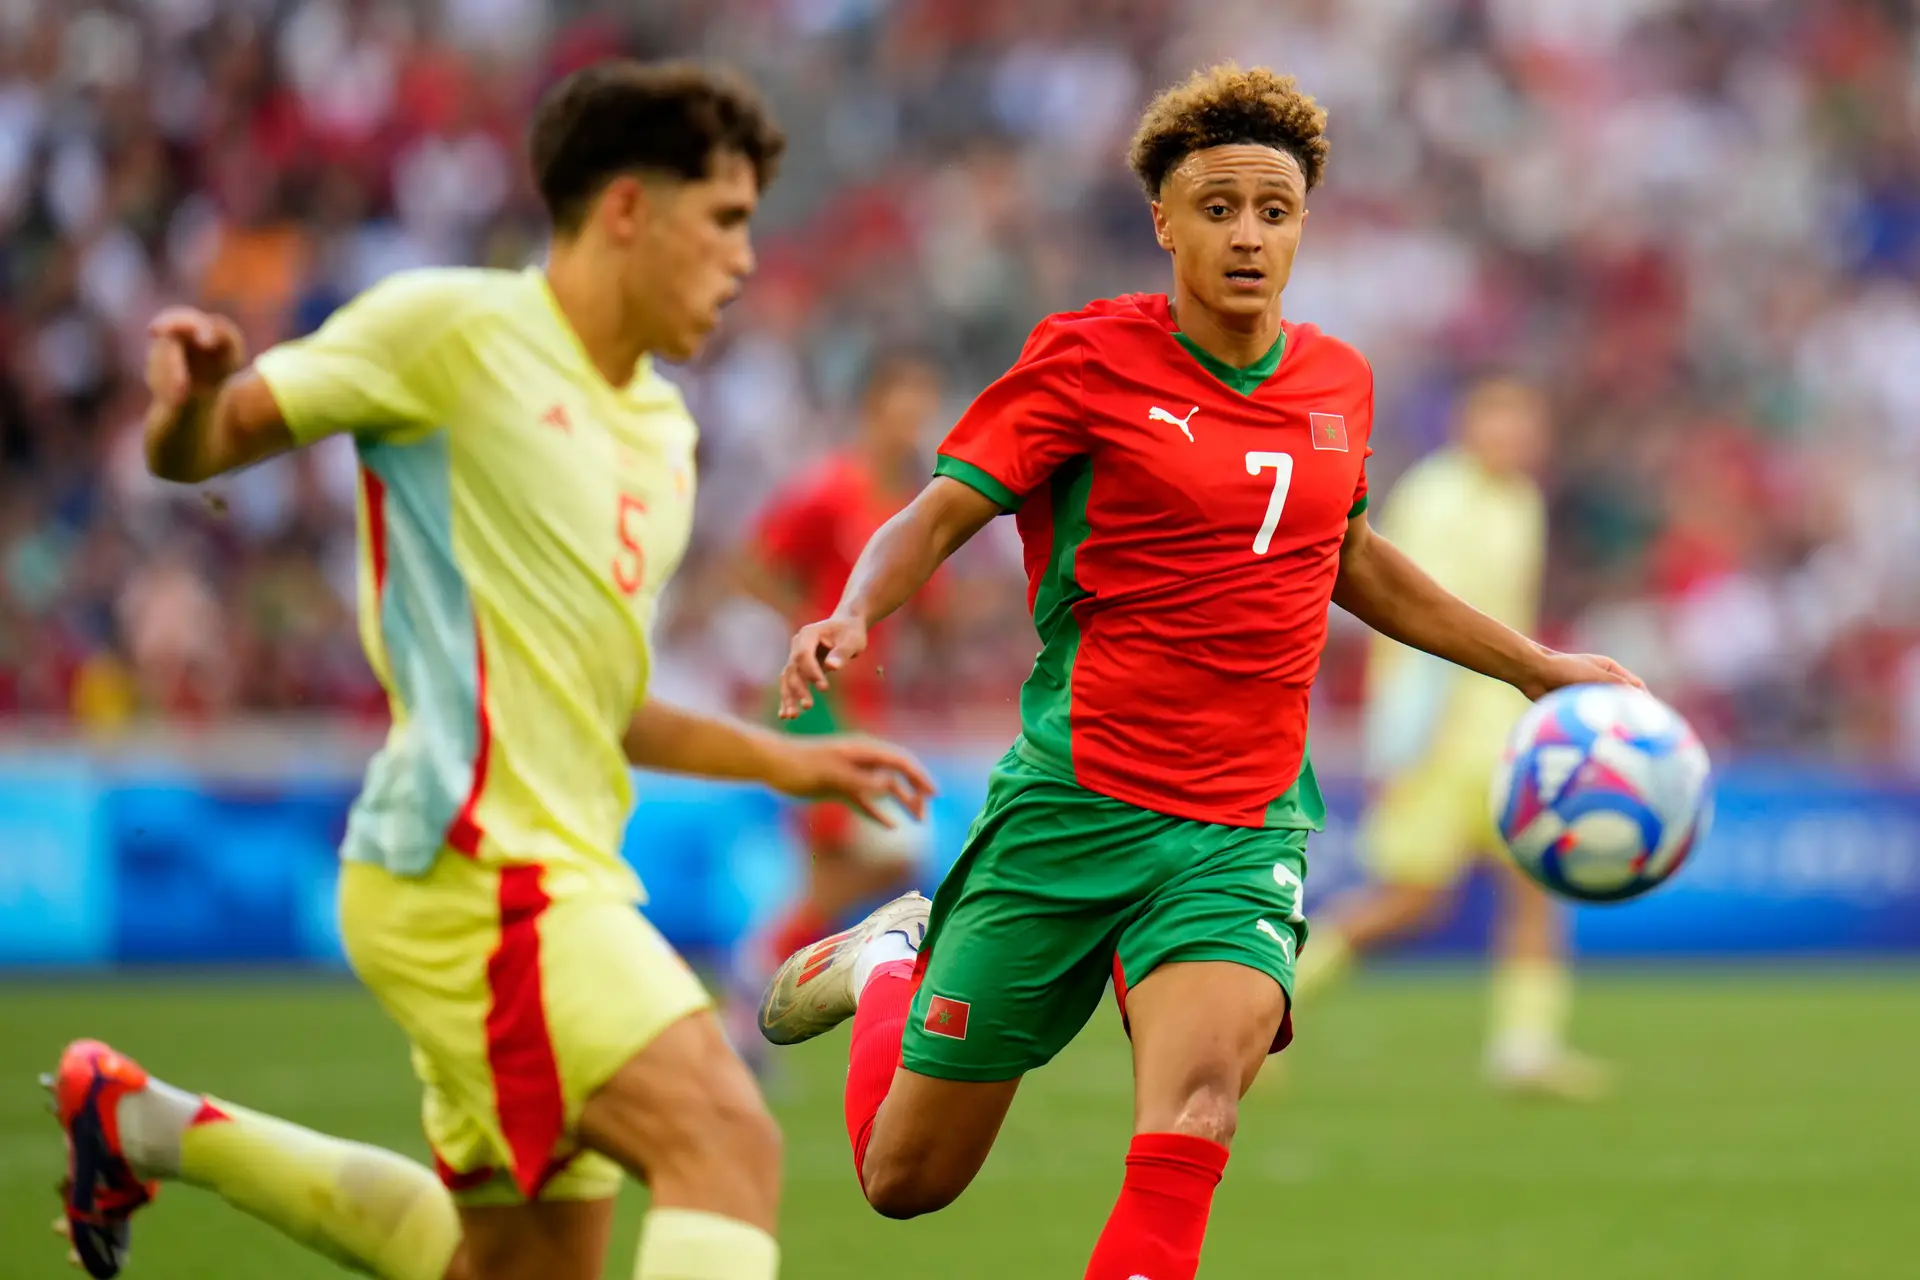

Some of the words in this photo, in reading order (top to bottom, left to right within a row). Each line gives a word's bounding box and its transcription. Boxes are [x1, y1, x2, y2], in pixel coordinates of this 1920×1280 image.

[612, 492, 646, 597] 5
[1245, 451, 1293, 555] 7
[1273, 863, 1304, 923] 7
